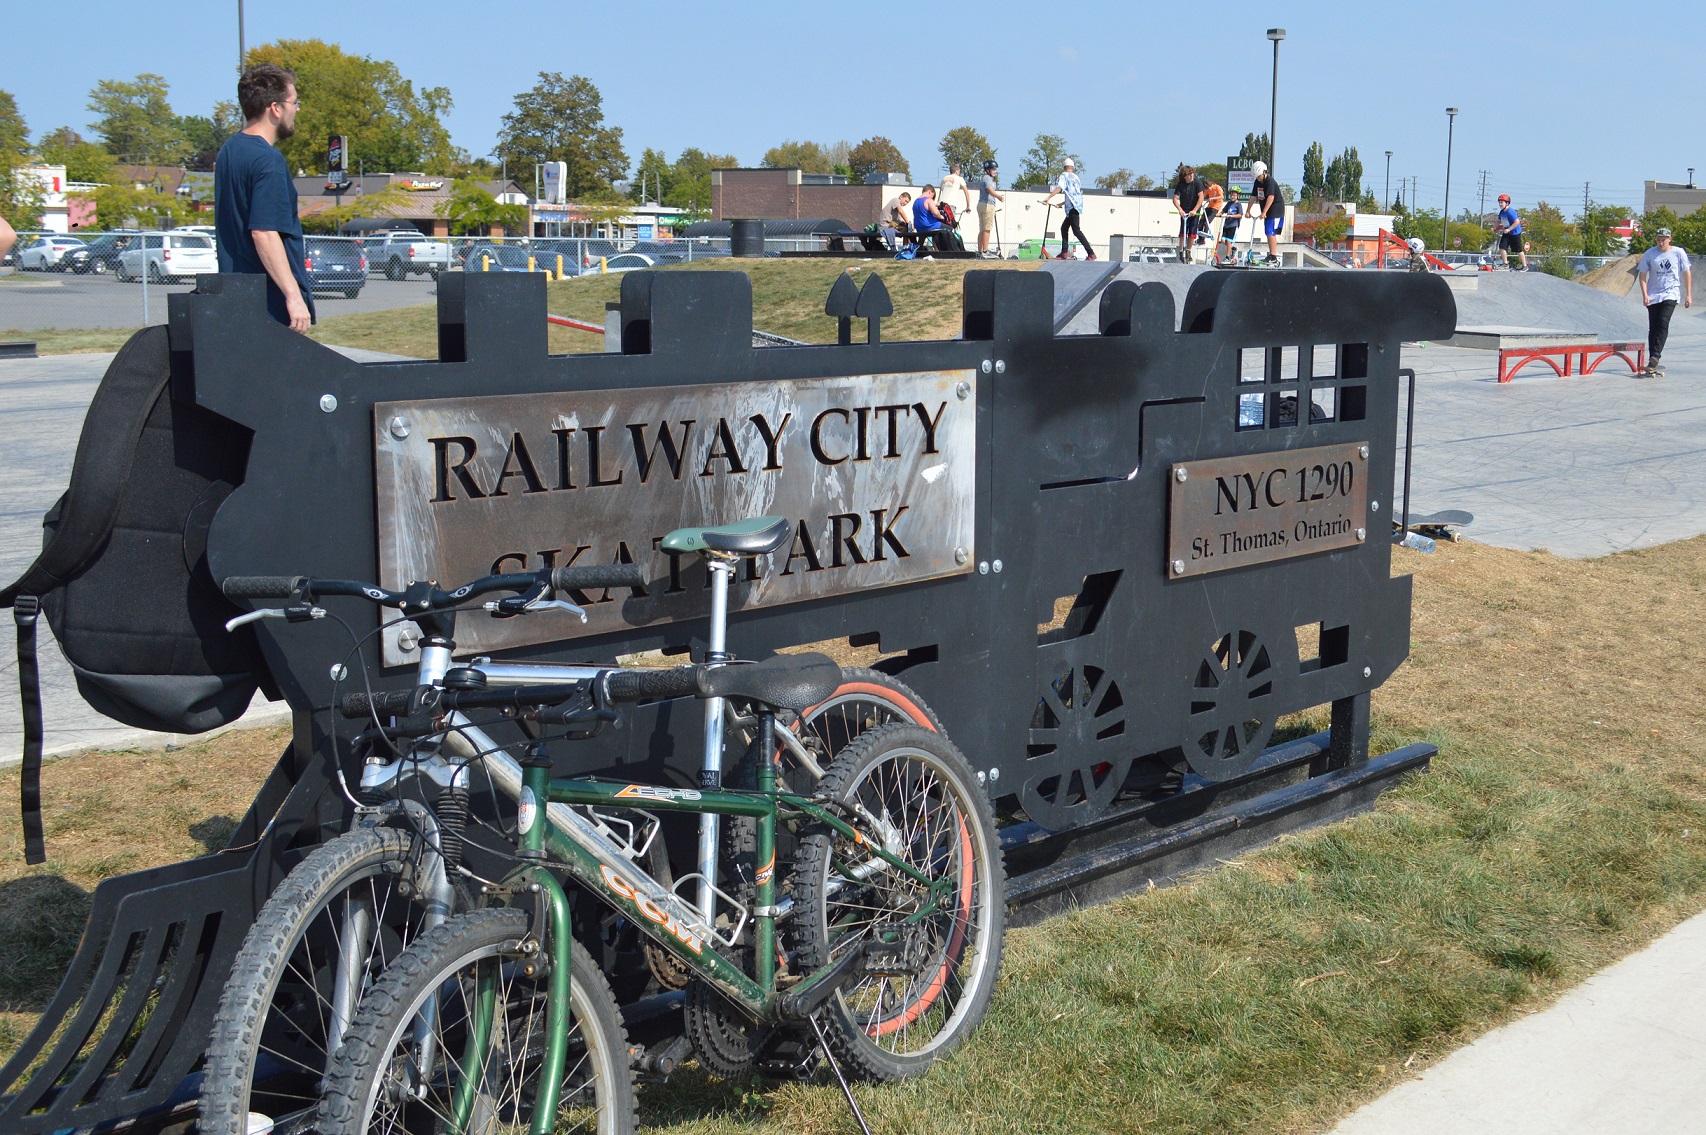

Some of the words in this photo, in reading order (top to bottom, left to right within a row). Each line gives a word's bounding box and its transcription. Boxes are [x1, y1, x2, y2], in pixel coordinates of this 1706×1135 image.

[412, 180, 430, 188] Pizza
[1233, 159, 1254, 169] LCBO
[429, 412, 792, 504] RAILWAY
[809, 401, 947, 466] CITY
[1214, 468, 1287, 516] NYC
[1295, 460, 1354, 503] 1290
[489, 505, 911, 619] KATARK
[1191, 537, 1214, 560] St.
[1220, 529, 1290, 555] Thomas,
[1294, 514, 1351, 542] Ontario
[600, 864, 703, 955] CCM
